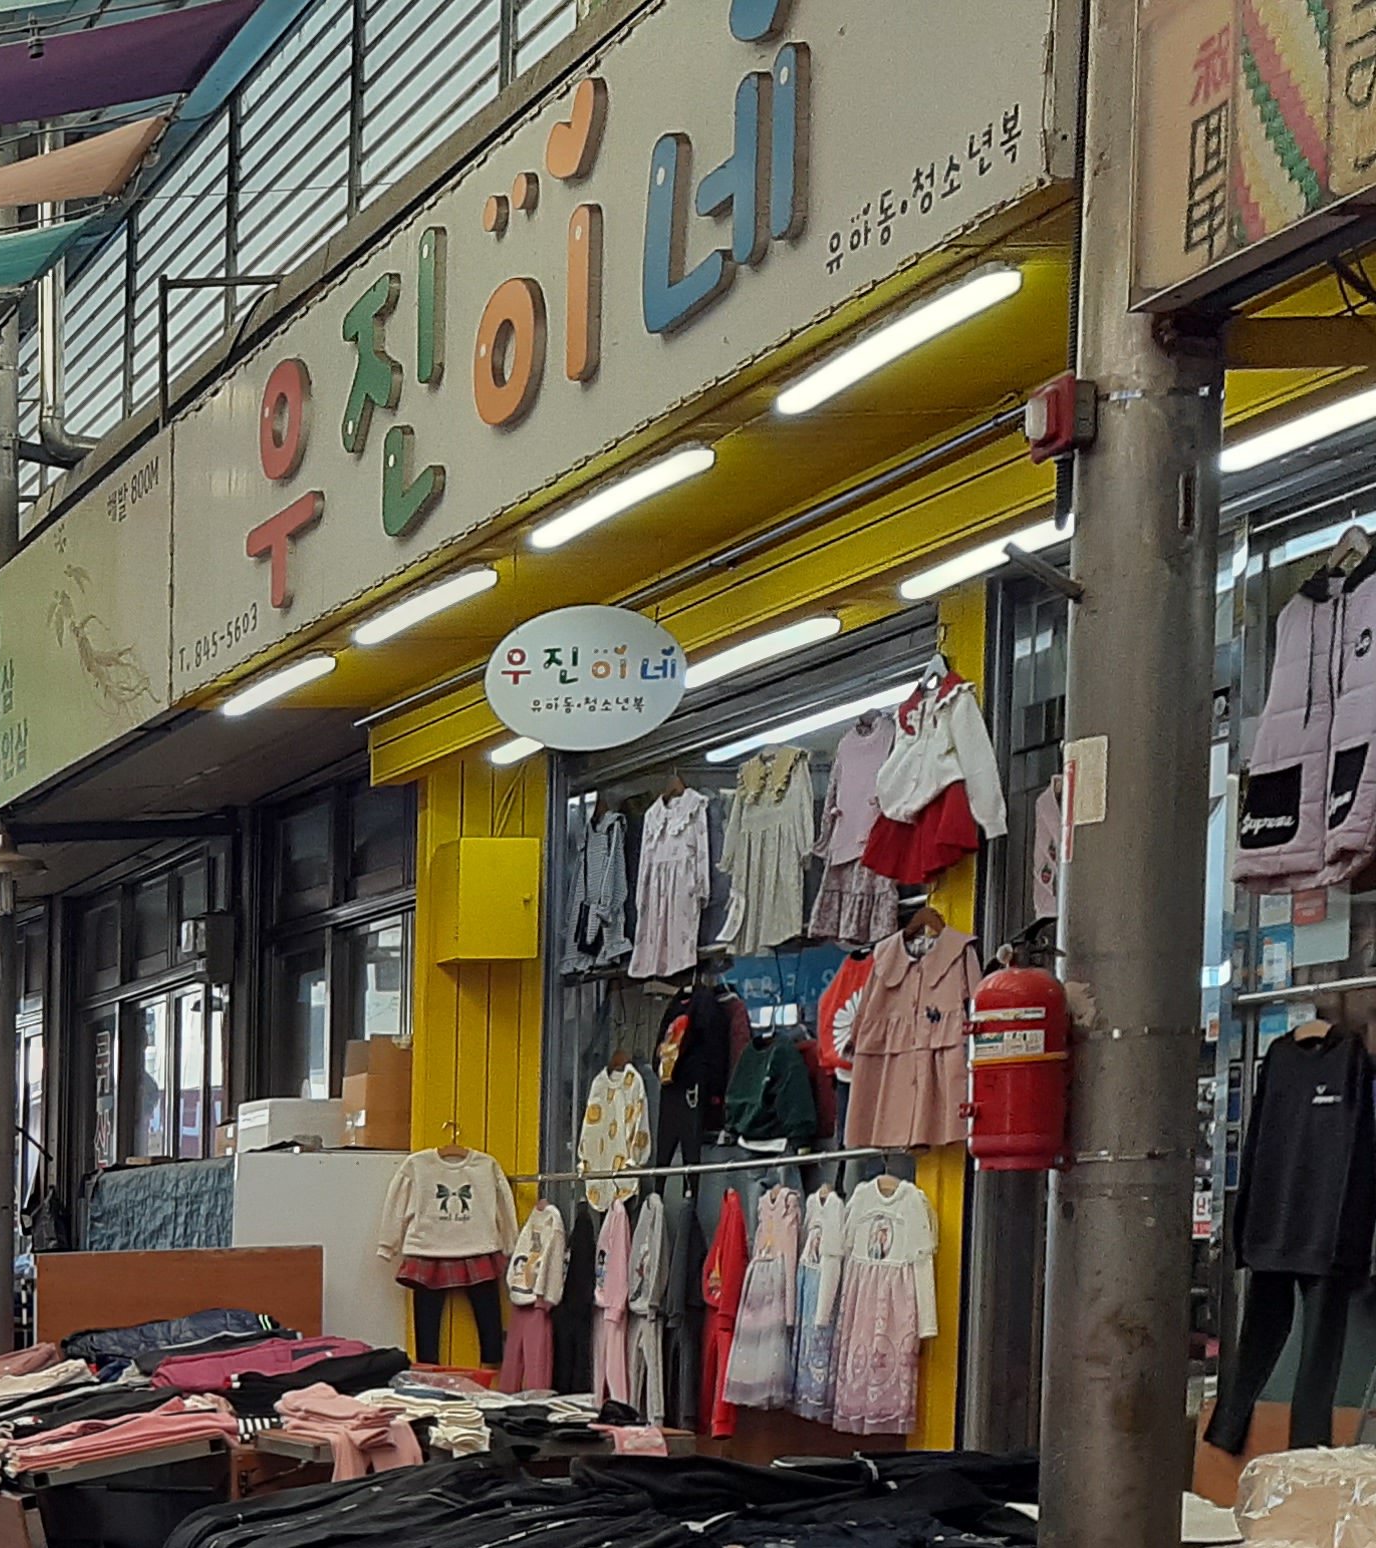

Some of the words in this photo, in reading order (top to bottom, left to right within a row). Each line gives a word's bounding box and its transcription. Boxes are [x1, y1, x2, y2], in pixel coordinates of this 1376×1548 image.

[248, 40, 812, 612] 우진이네
[195, 603, 261, 662] 845-5603
[501, 645, 677, 685] 우진이네
